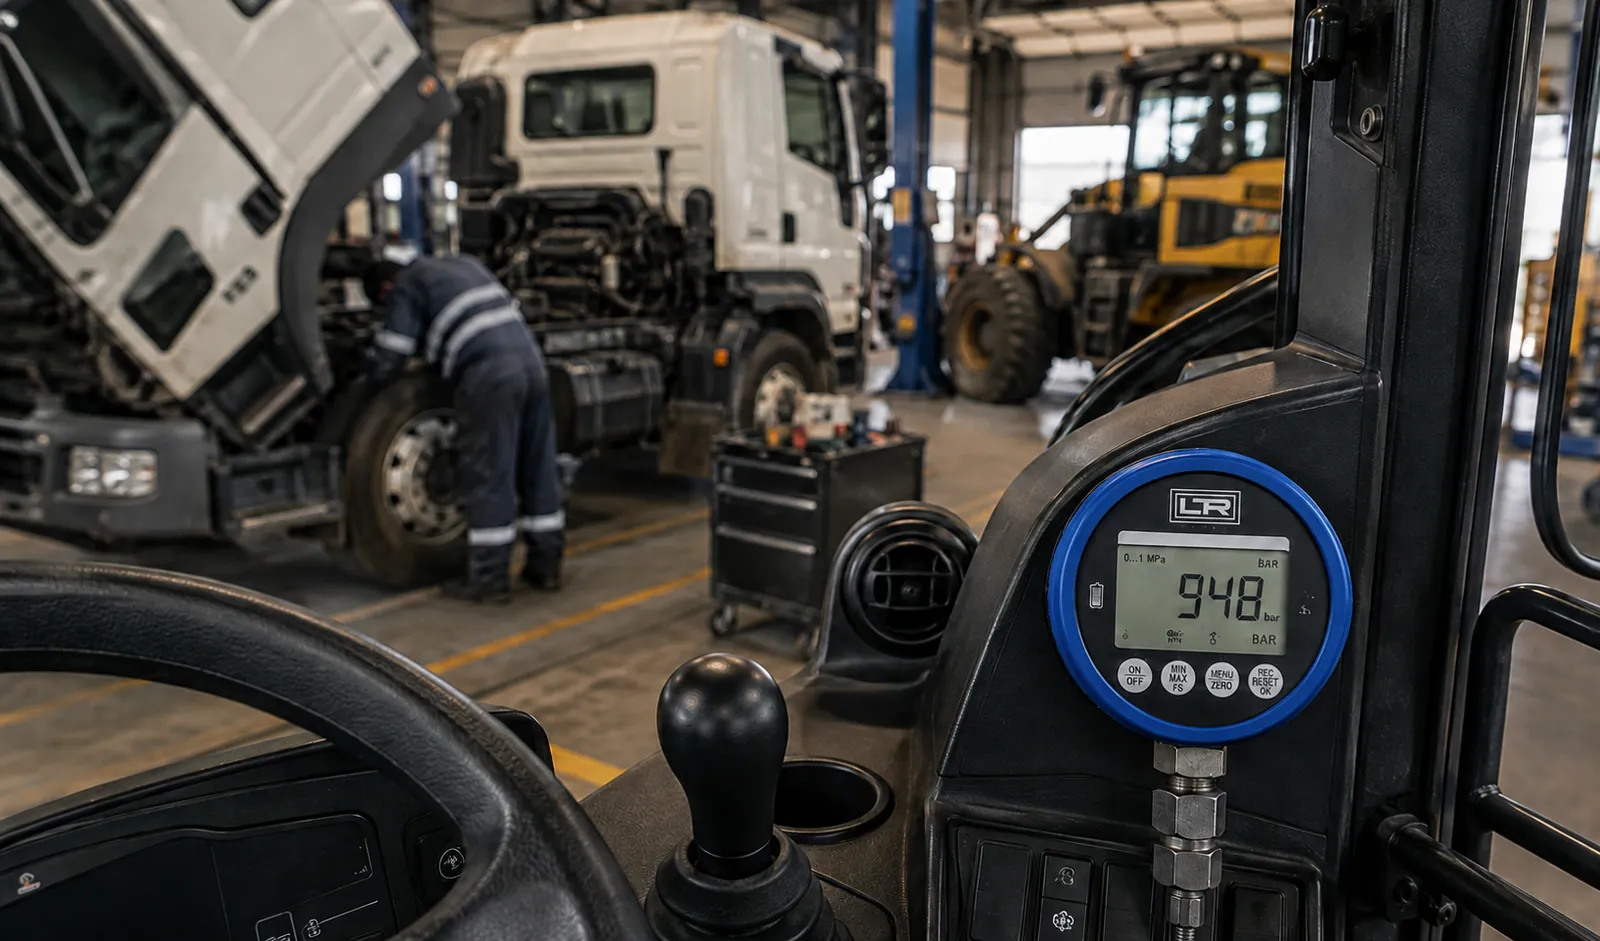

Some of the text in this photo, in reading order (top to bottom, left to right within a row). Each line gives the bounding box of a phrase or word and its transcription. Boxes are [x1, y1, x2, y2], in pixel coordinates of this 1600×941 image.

[1180, 498, 1231, 516] LTR
[1124, 553, 1166, 563] 0...1 MPa
[1178, 573, 1264, 621] 948
[1264, 612, 1280, 622] bar
[1252, 634, 1276, 645] BAR
[1128, 666, 1141, 674] ON
[1170, 665, 1186, 673] MIN
[1258, 668, 1274, 677] REC
[1168, 674, 1188, 683] MAX
[1211, 670, 1233, 678] MENU
[1126, 677, 1144, 686] OFF
[1211, 681, 1232, 690] ZERO
[1252, 677, 1279, 687] RESET
[1173, 684, 1184, 692] FS
[1260, 688, 1272, 696] OK
